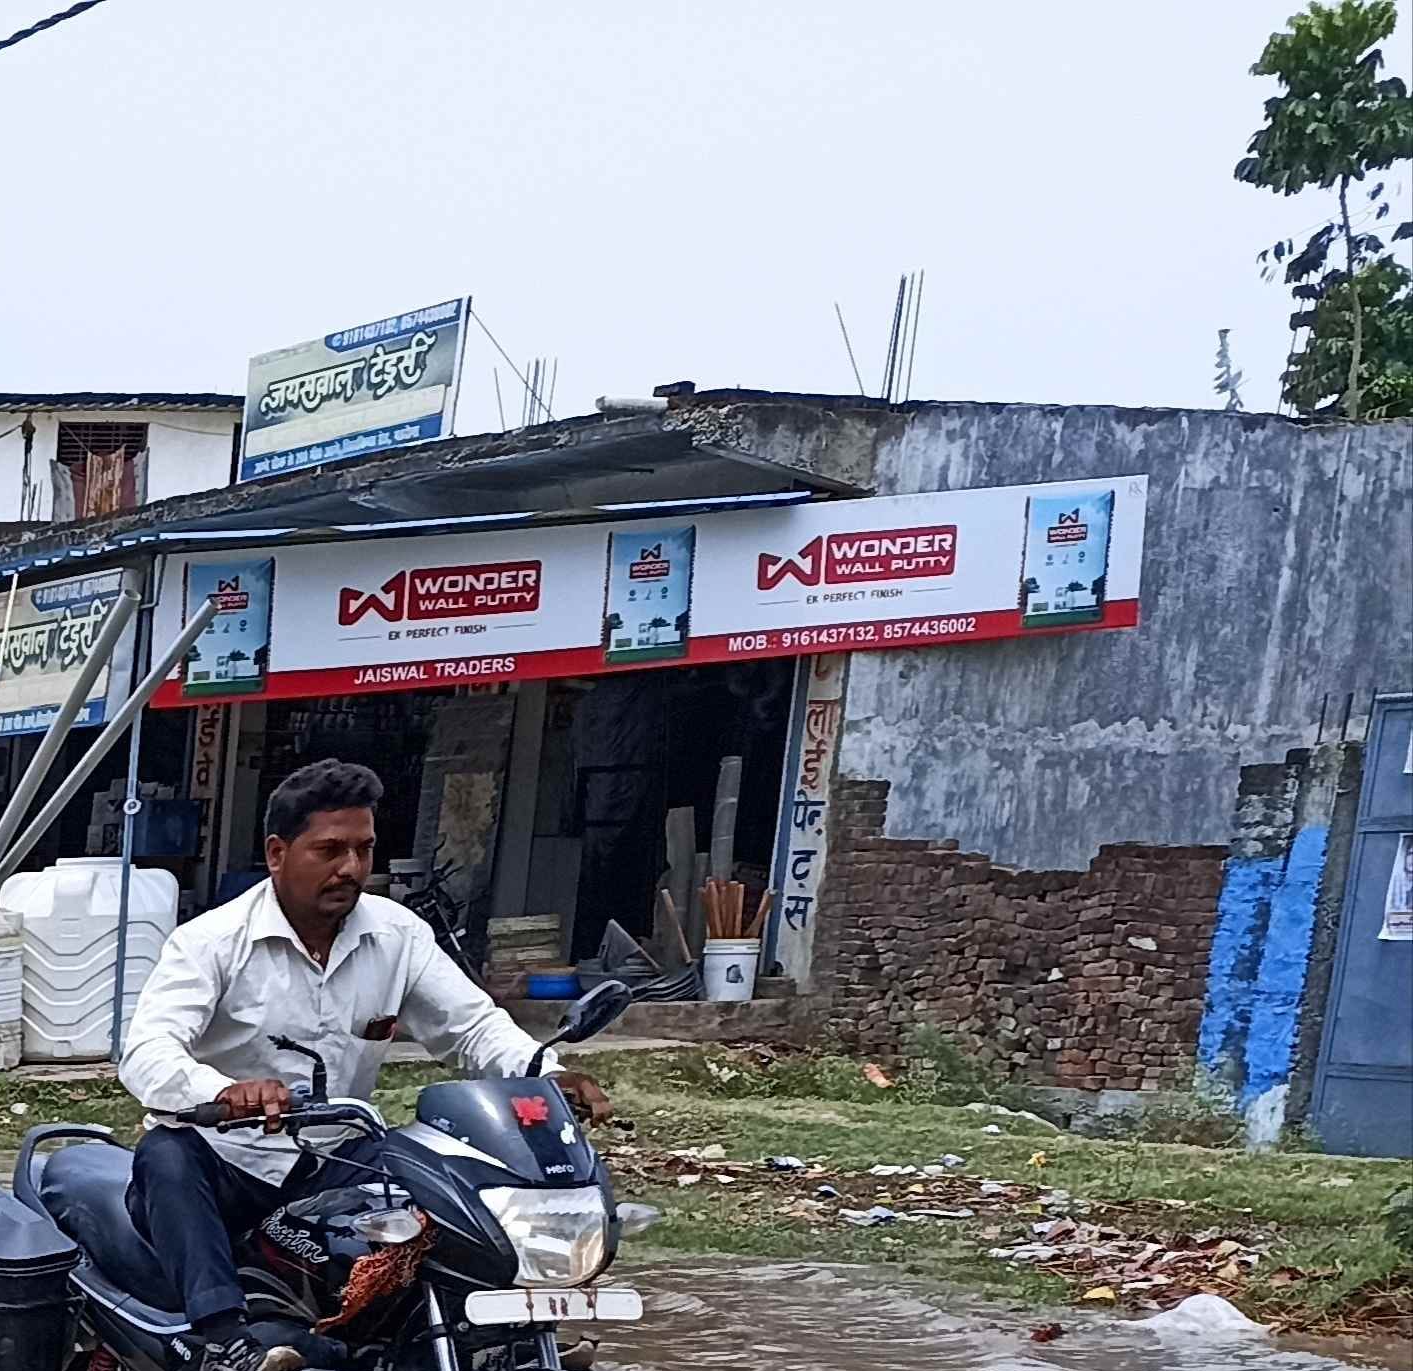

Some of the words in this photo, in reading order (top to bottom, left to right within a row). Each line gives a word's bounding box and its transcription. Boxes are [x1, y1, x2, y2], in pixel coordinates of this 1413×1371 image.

[830, 533, 953, 559] WONDER
[835, 562, 884, 575] WALL
[891, 556, 950, 571] PUTTY
[414, 569, 537, 595] WONDER
[419, 598, 469, 611] WALL
[475, 591, 534, 606] PUTTY
[823, 591, 866, 602] PERFECT
[871, 588, 903, 598] FINISH
[406, 626, 449, 639] PERFECT
[454, 624, 486, 634] FINISH
[782, 626, 879, 648] 9161437132,
[883, 617, 976, 639] 8574436002
[354, 665, 429, 685] JAISWAL
[435, 657, 515, 677] TRADERS
